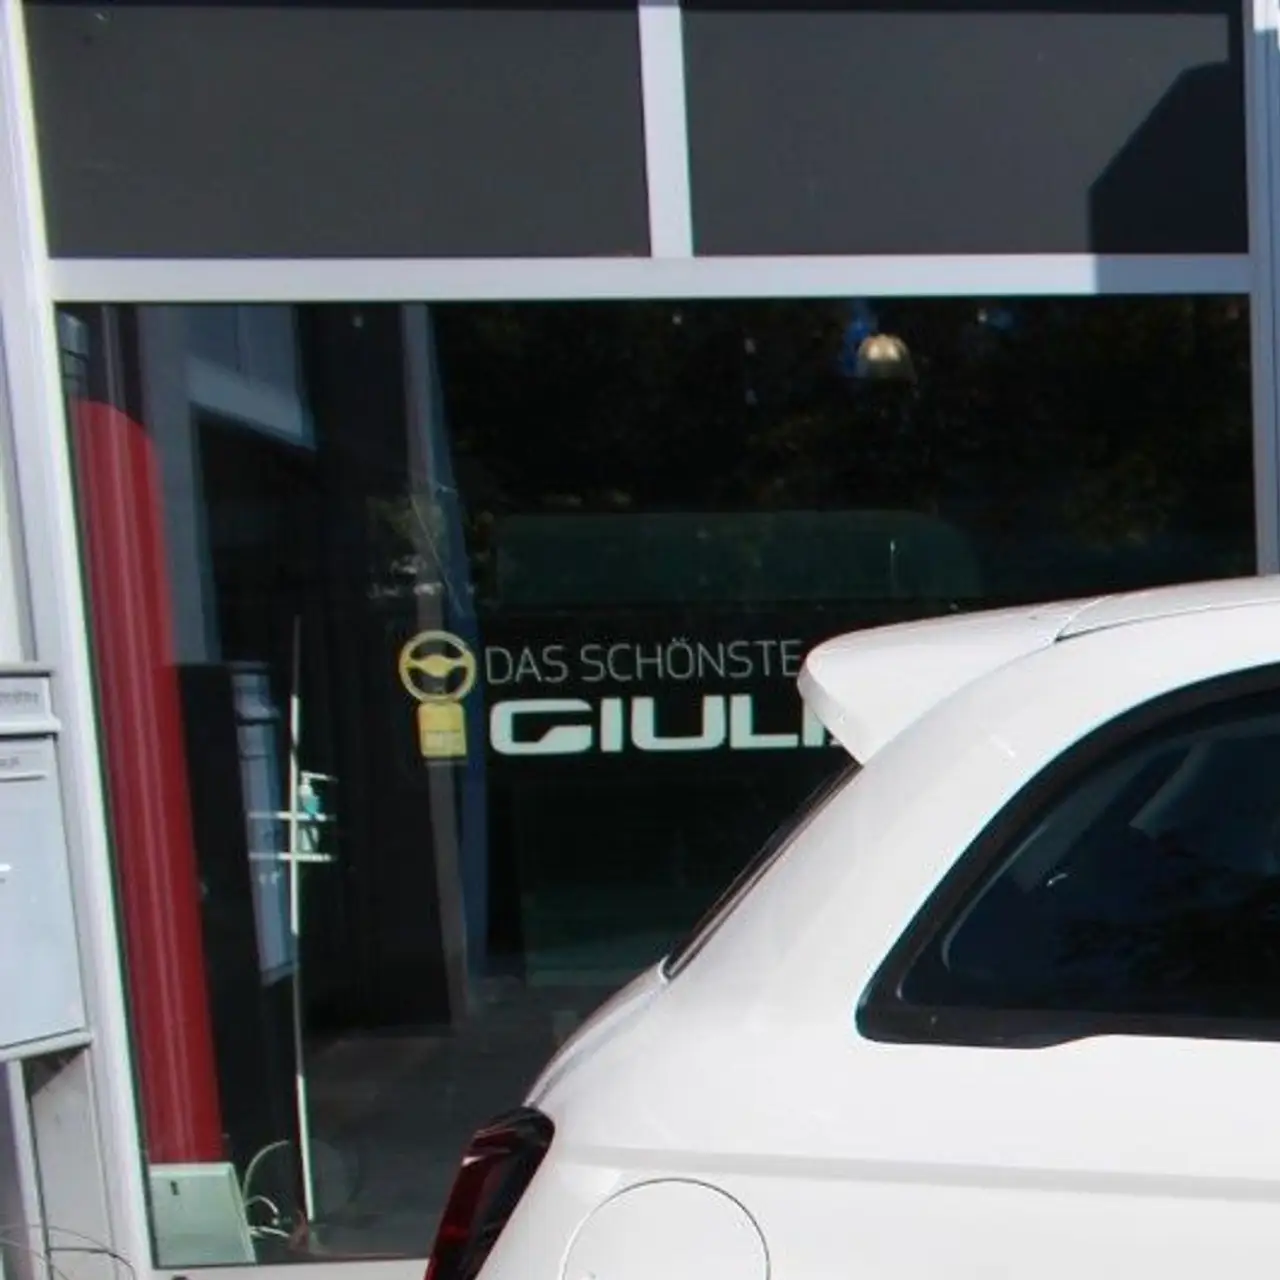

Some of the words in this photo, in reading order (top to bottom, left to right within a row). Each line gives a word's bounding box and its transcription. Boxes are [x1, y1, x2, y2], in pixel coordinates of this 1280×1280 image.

[486, 643, 569, 685] DAS
[580, 636, 803, 682] SCHÖNSTE
[489, 694, 842, 755] GIULI
